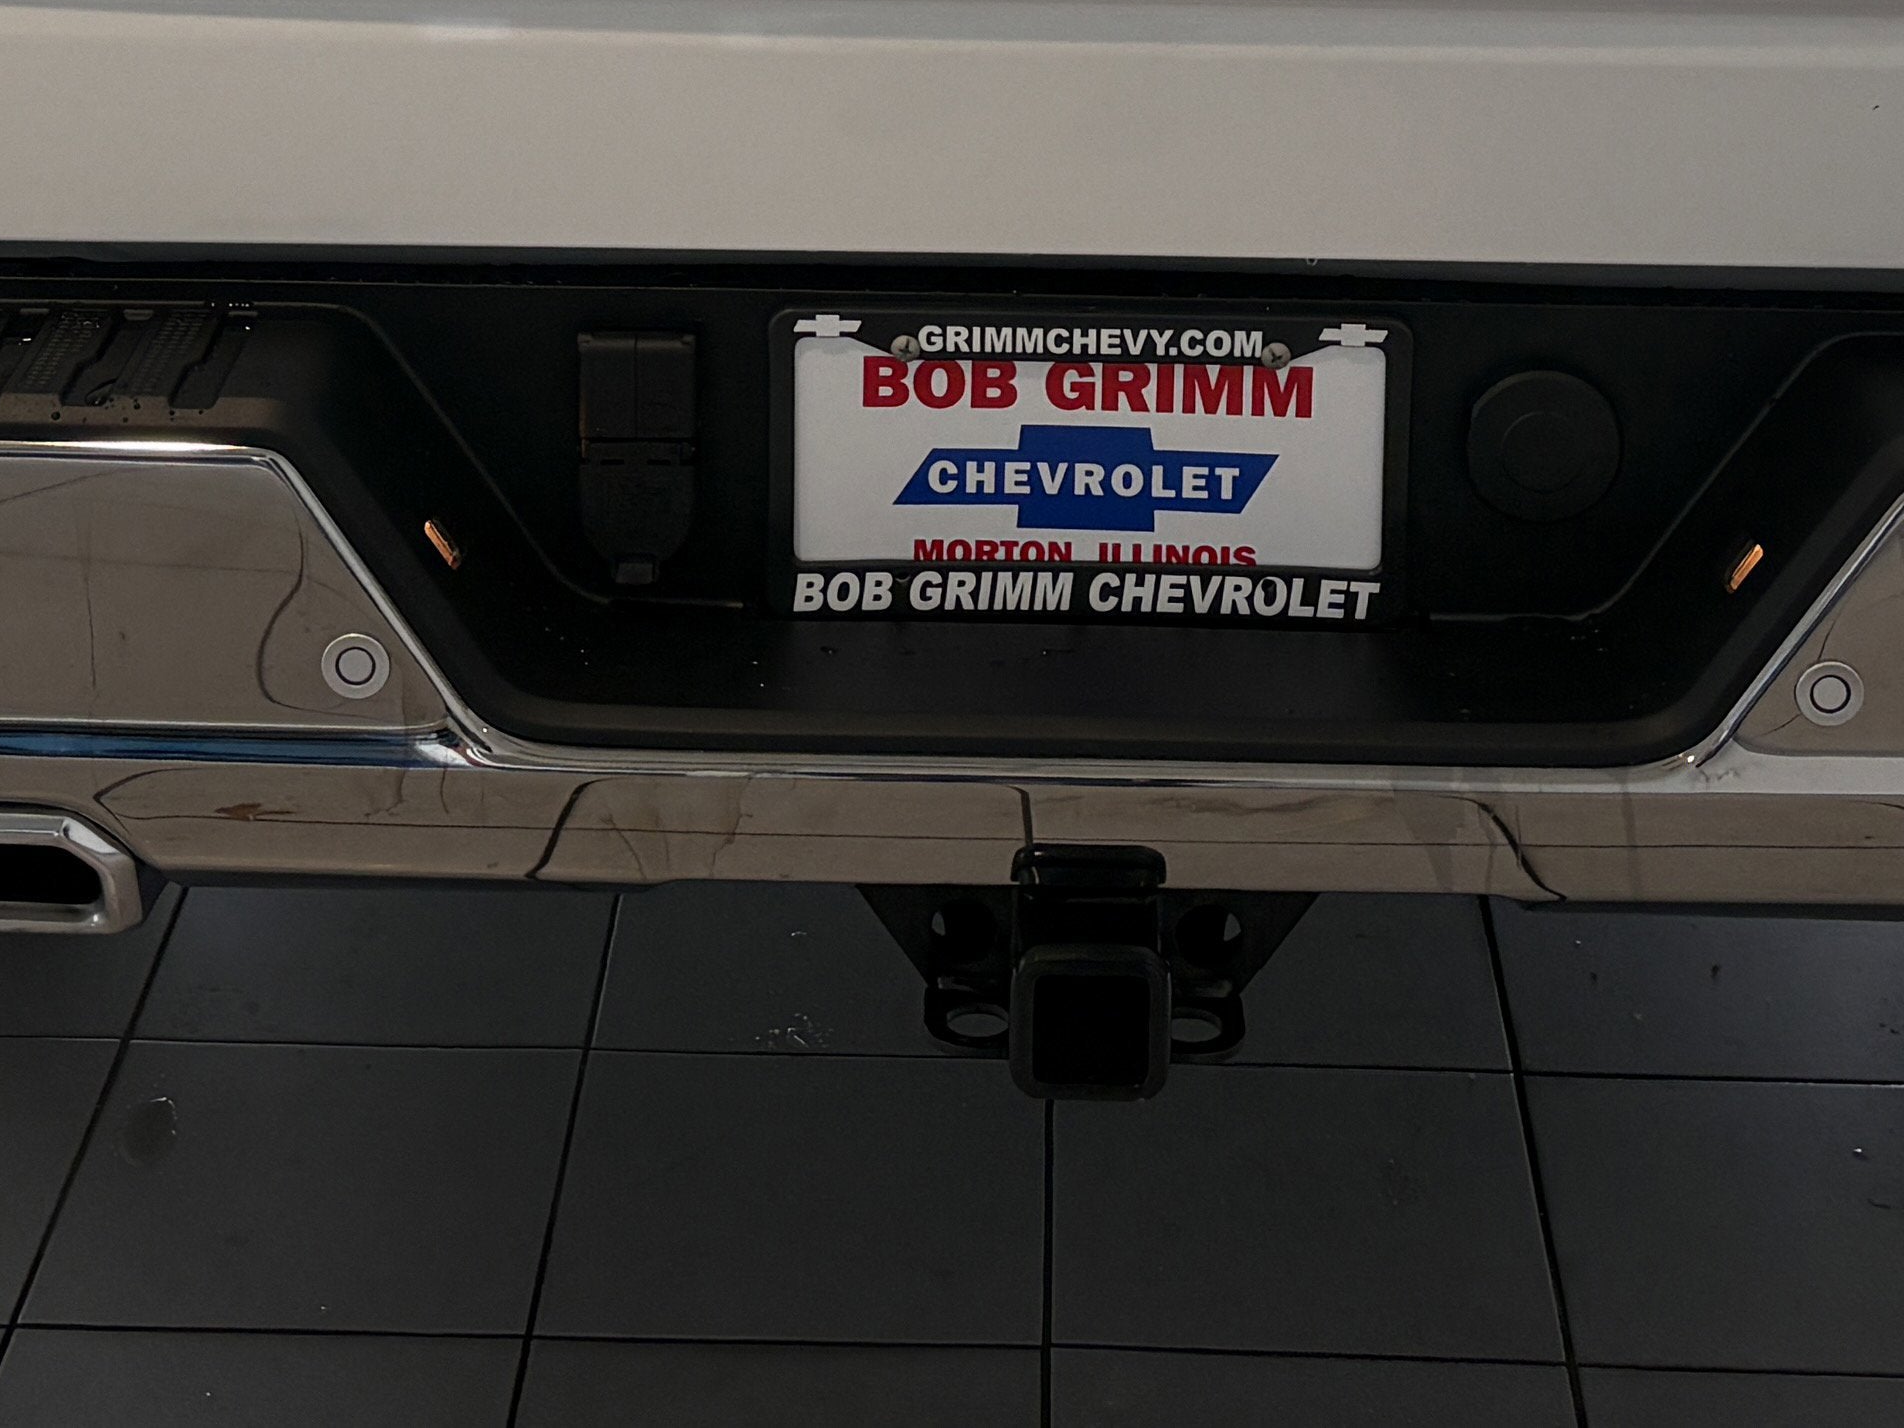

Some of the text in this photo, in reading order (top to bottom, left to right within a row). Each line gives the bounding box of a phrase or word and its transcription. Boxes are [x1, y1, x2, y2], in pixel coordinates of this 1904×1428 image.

[917, 324, 1264, 359] GRIMMCHEVY.COM
[862, 356, 1315, 419] BOB GRIMM
[928, 460, 1240, 501] CHEVROLET
[793, 572, 1382, 620] BOB GRIMM CHEVROLET
